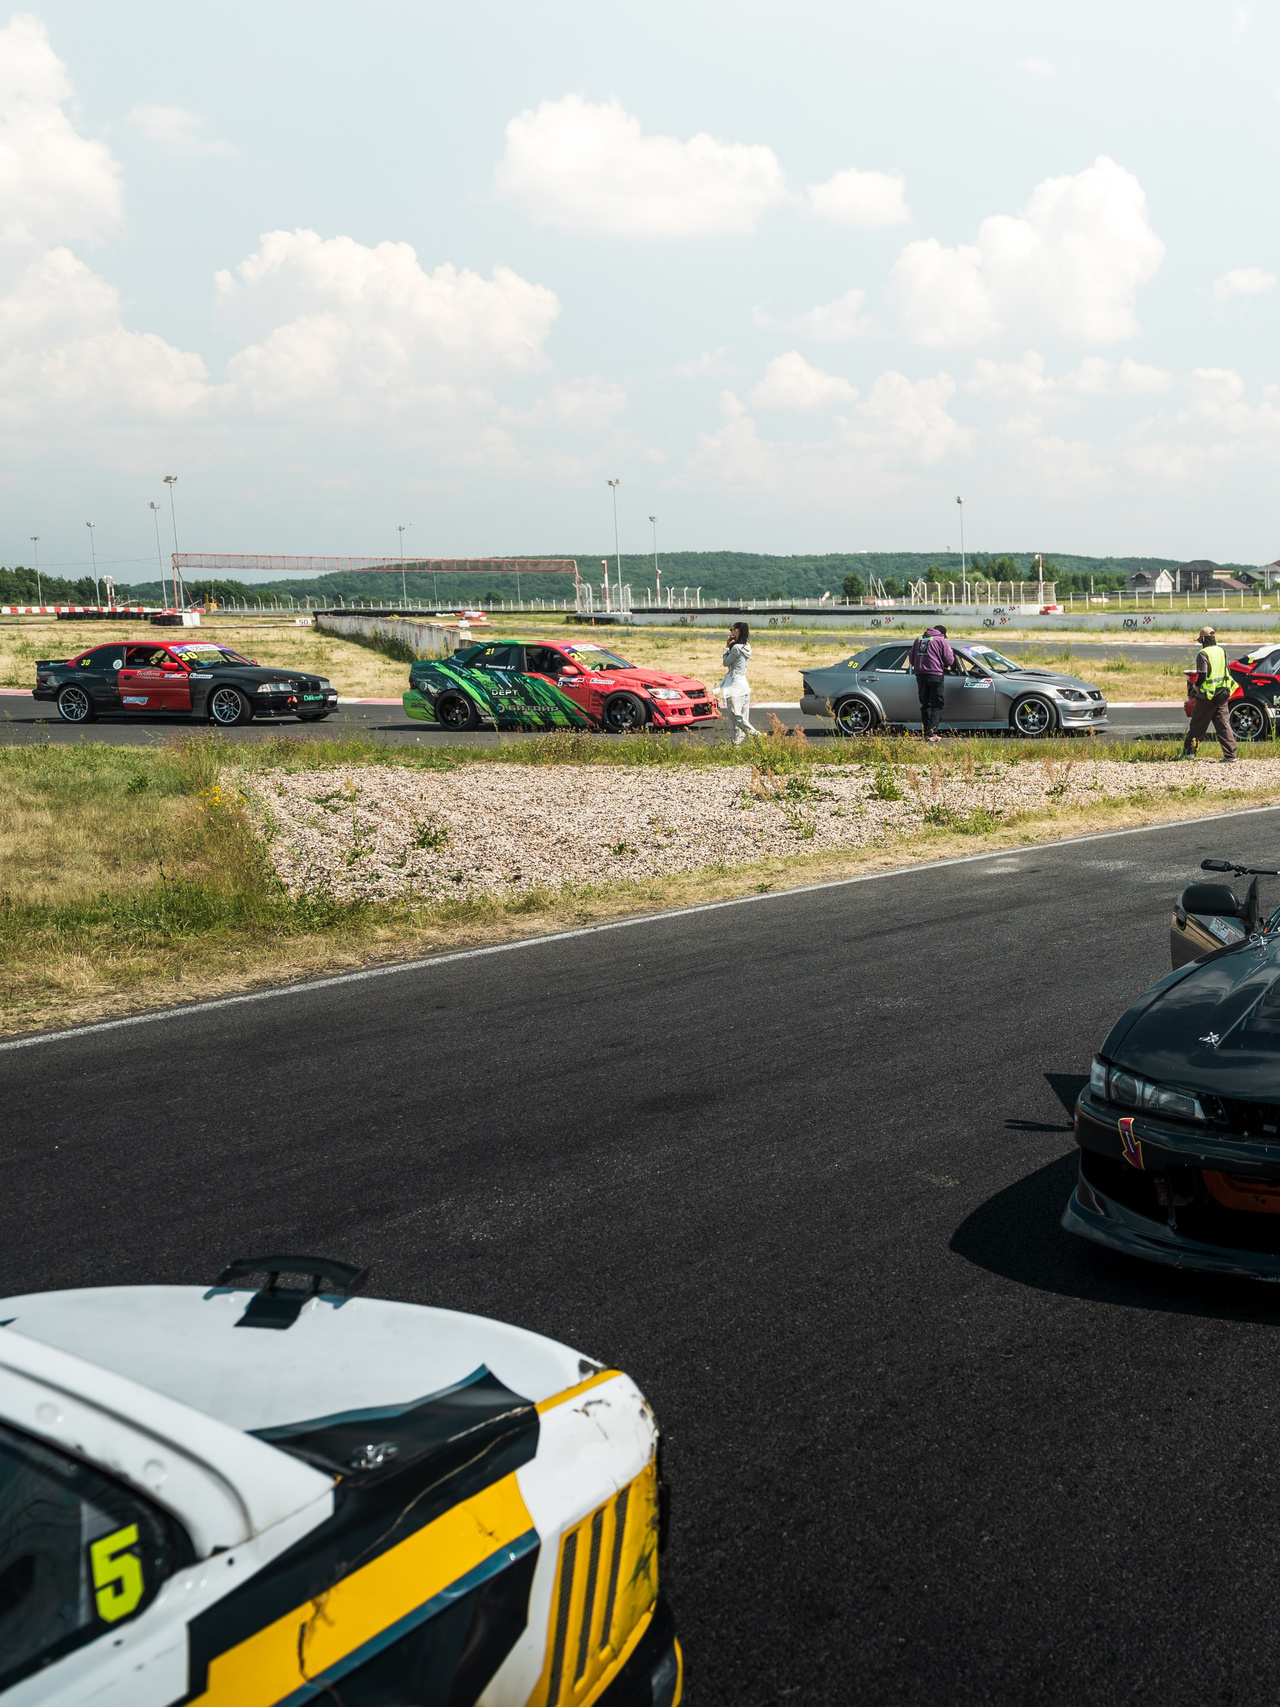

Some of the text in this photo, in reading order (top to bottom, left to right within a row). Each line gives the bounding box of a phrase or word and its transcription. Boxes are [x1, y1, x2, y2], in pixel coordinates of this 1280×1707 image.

[1123, 619, 1138, 627] ADM
[485, 647, 495, 655] 21
[178, 651, 198, 661] 30
[570, 652, 586, 661] 21
[847, 660, 859, 669] 90
[90, 1522, 145, 1623] 5
